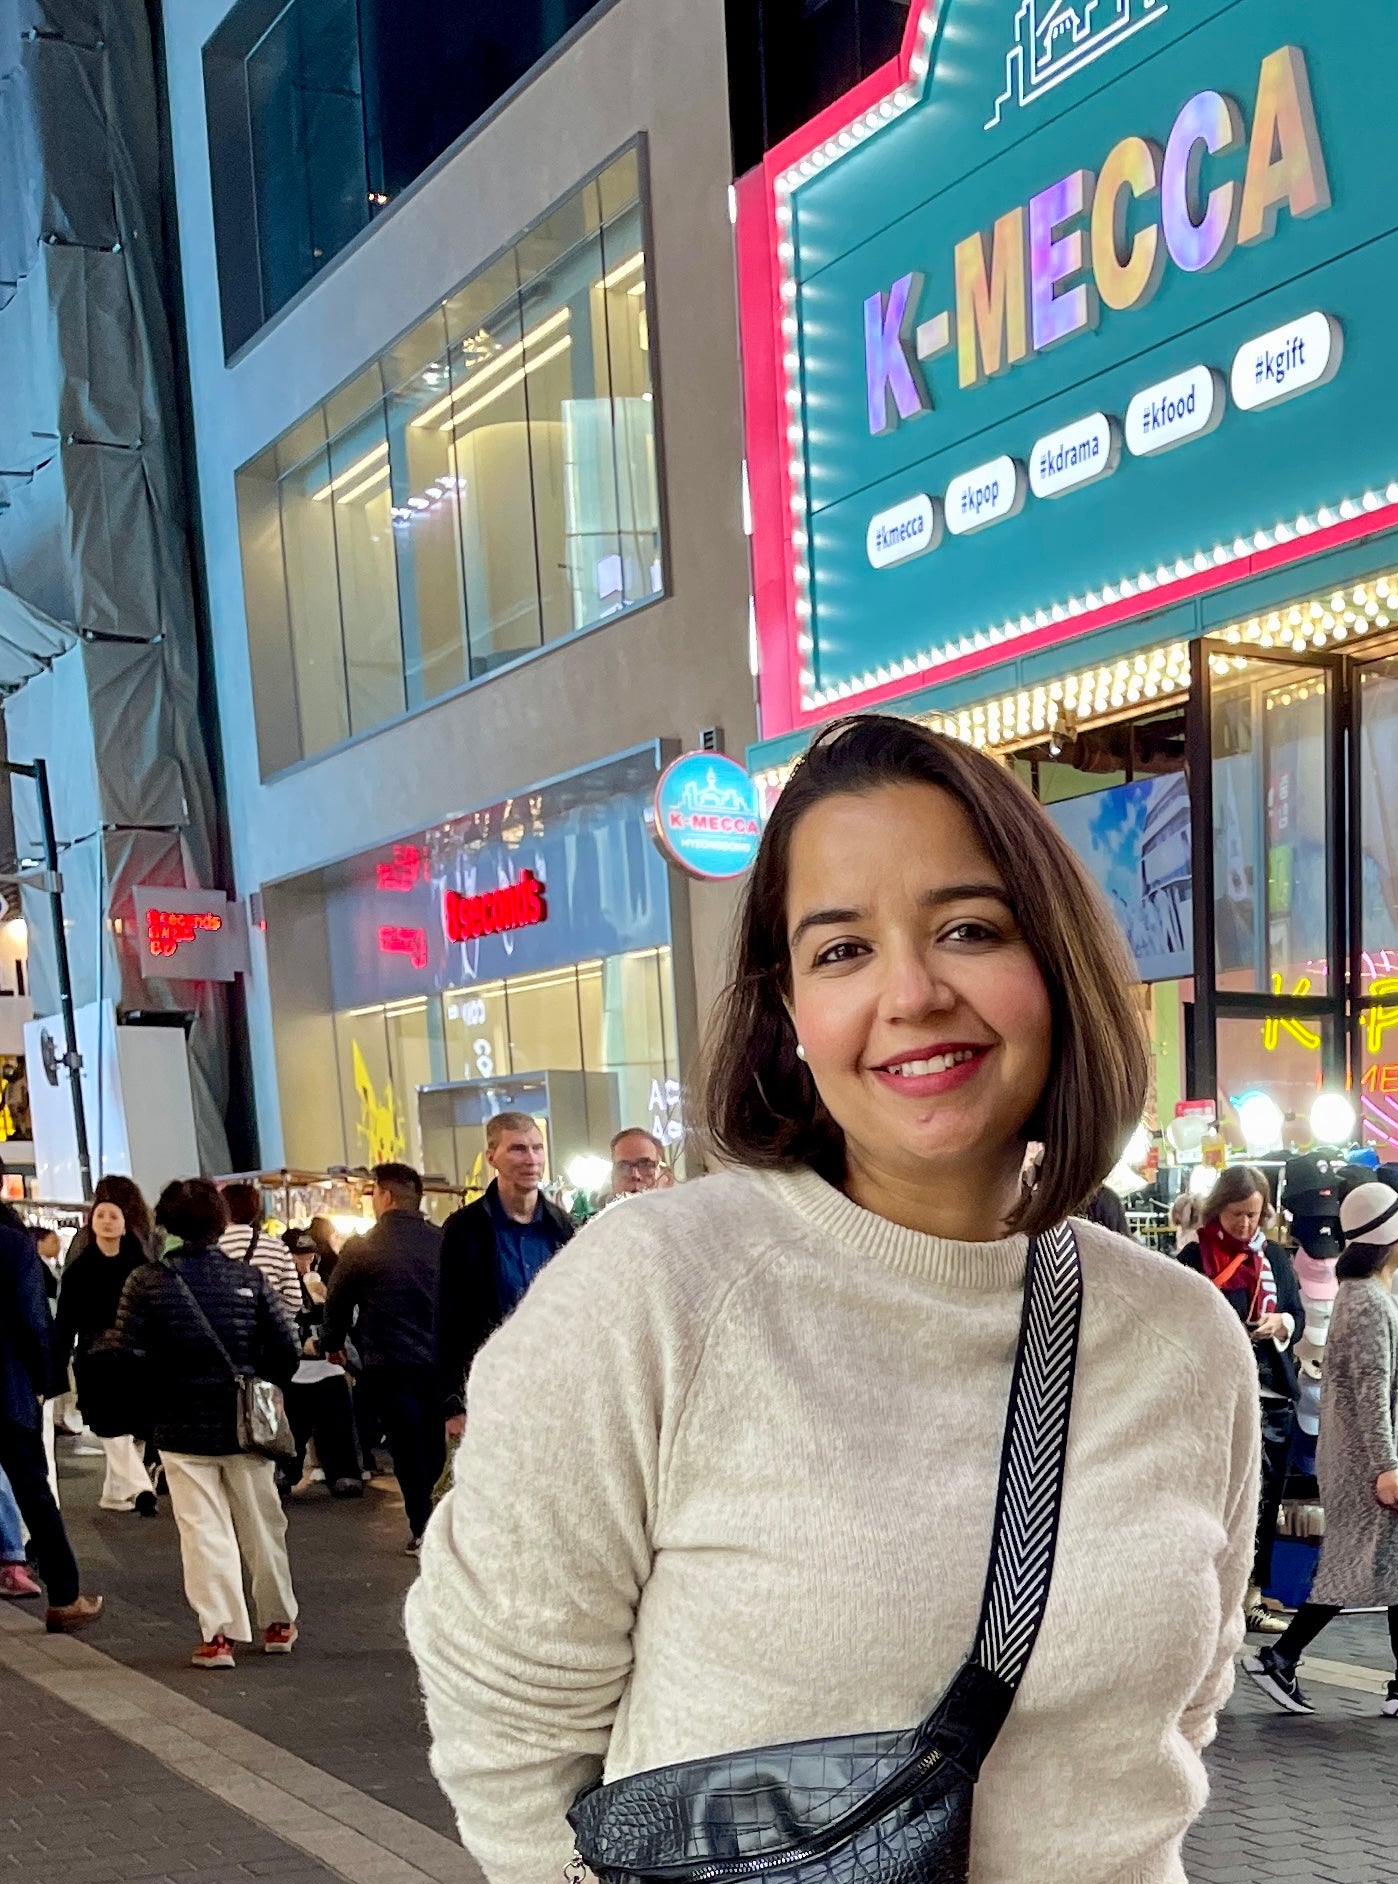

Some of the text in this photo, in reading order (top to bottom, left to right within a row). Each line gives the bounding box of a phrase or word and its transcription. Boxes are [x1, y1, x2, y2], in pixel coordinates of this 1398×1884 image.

[862, 44, 1331, 436] K-MECCA
[875, 336, 1306, 552] #kmecca #kpop #kdrama #kfood #kgift
[669, 811, 760, 835] K-MECCA
